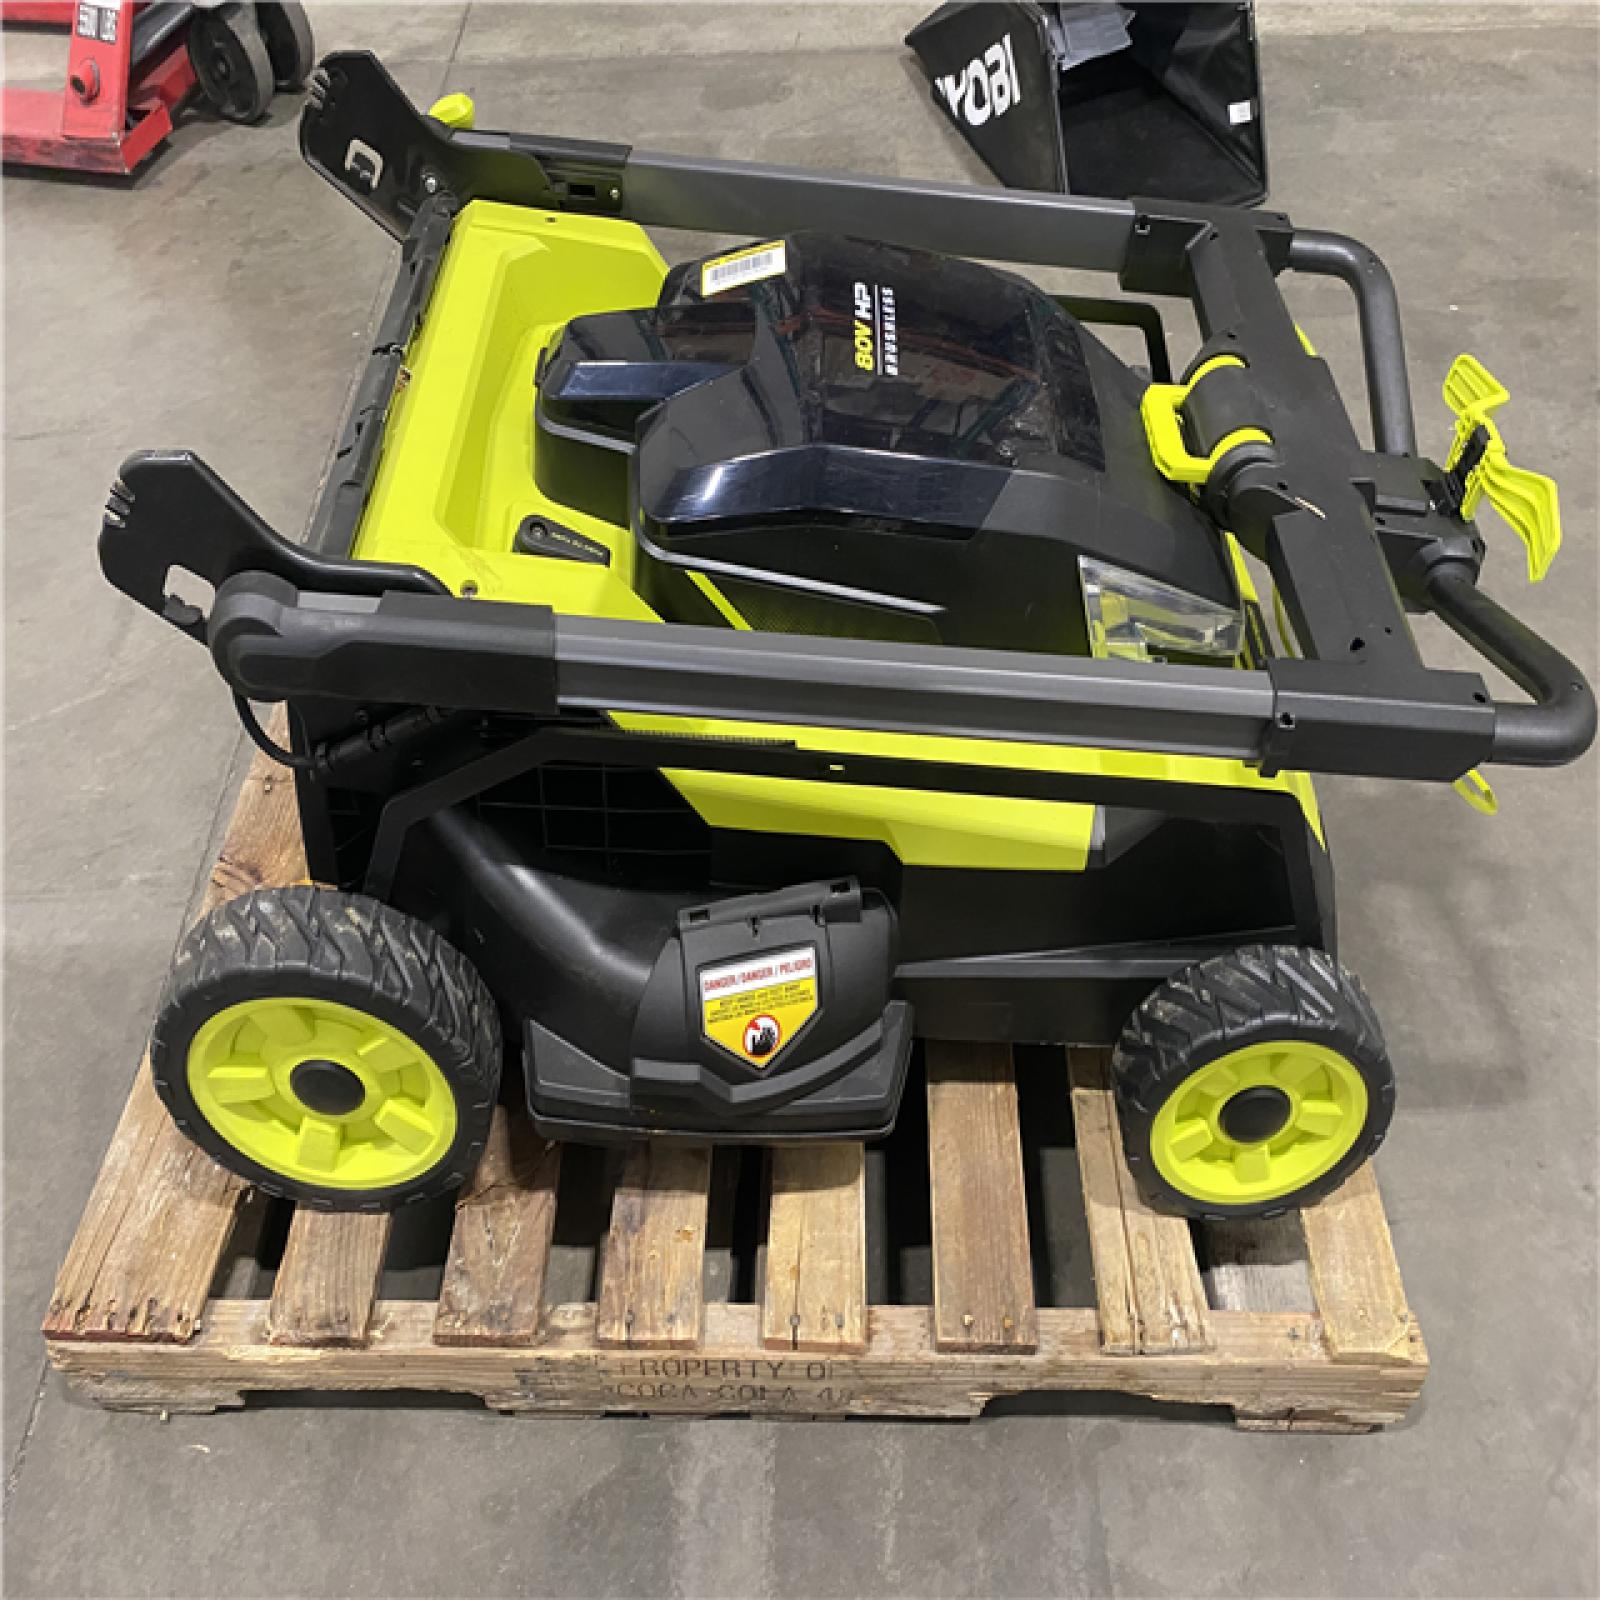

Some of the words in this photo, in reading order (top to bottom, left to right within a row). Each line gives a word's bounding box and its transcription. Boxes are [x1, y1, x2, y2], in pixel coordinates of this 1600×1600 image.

[934, 32, 1021, 126] YOBI
[854, 282, 872, 320] HP
[854, 319, 874, 371] 80V
